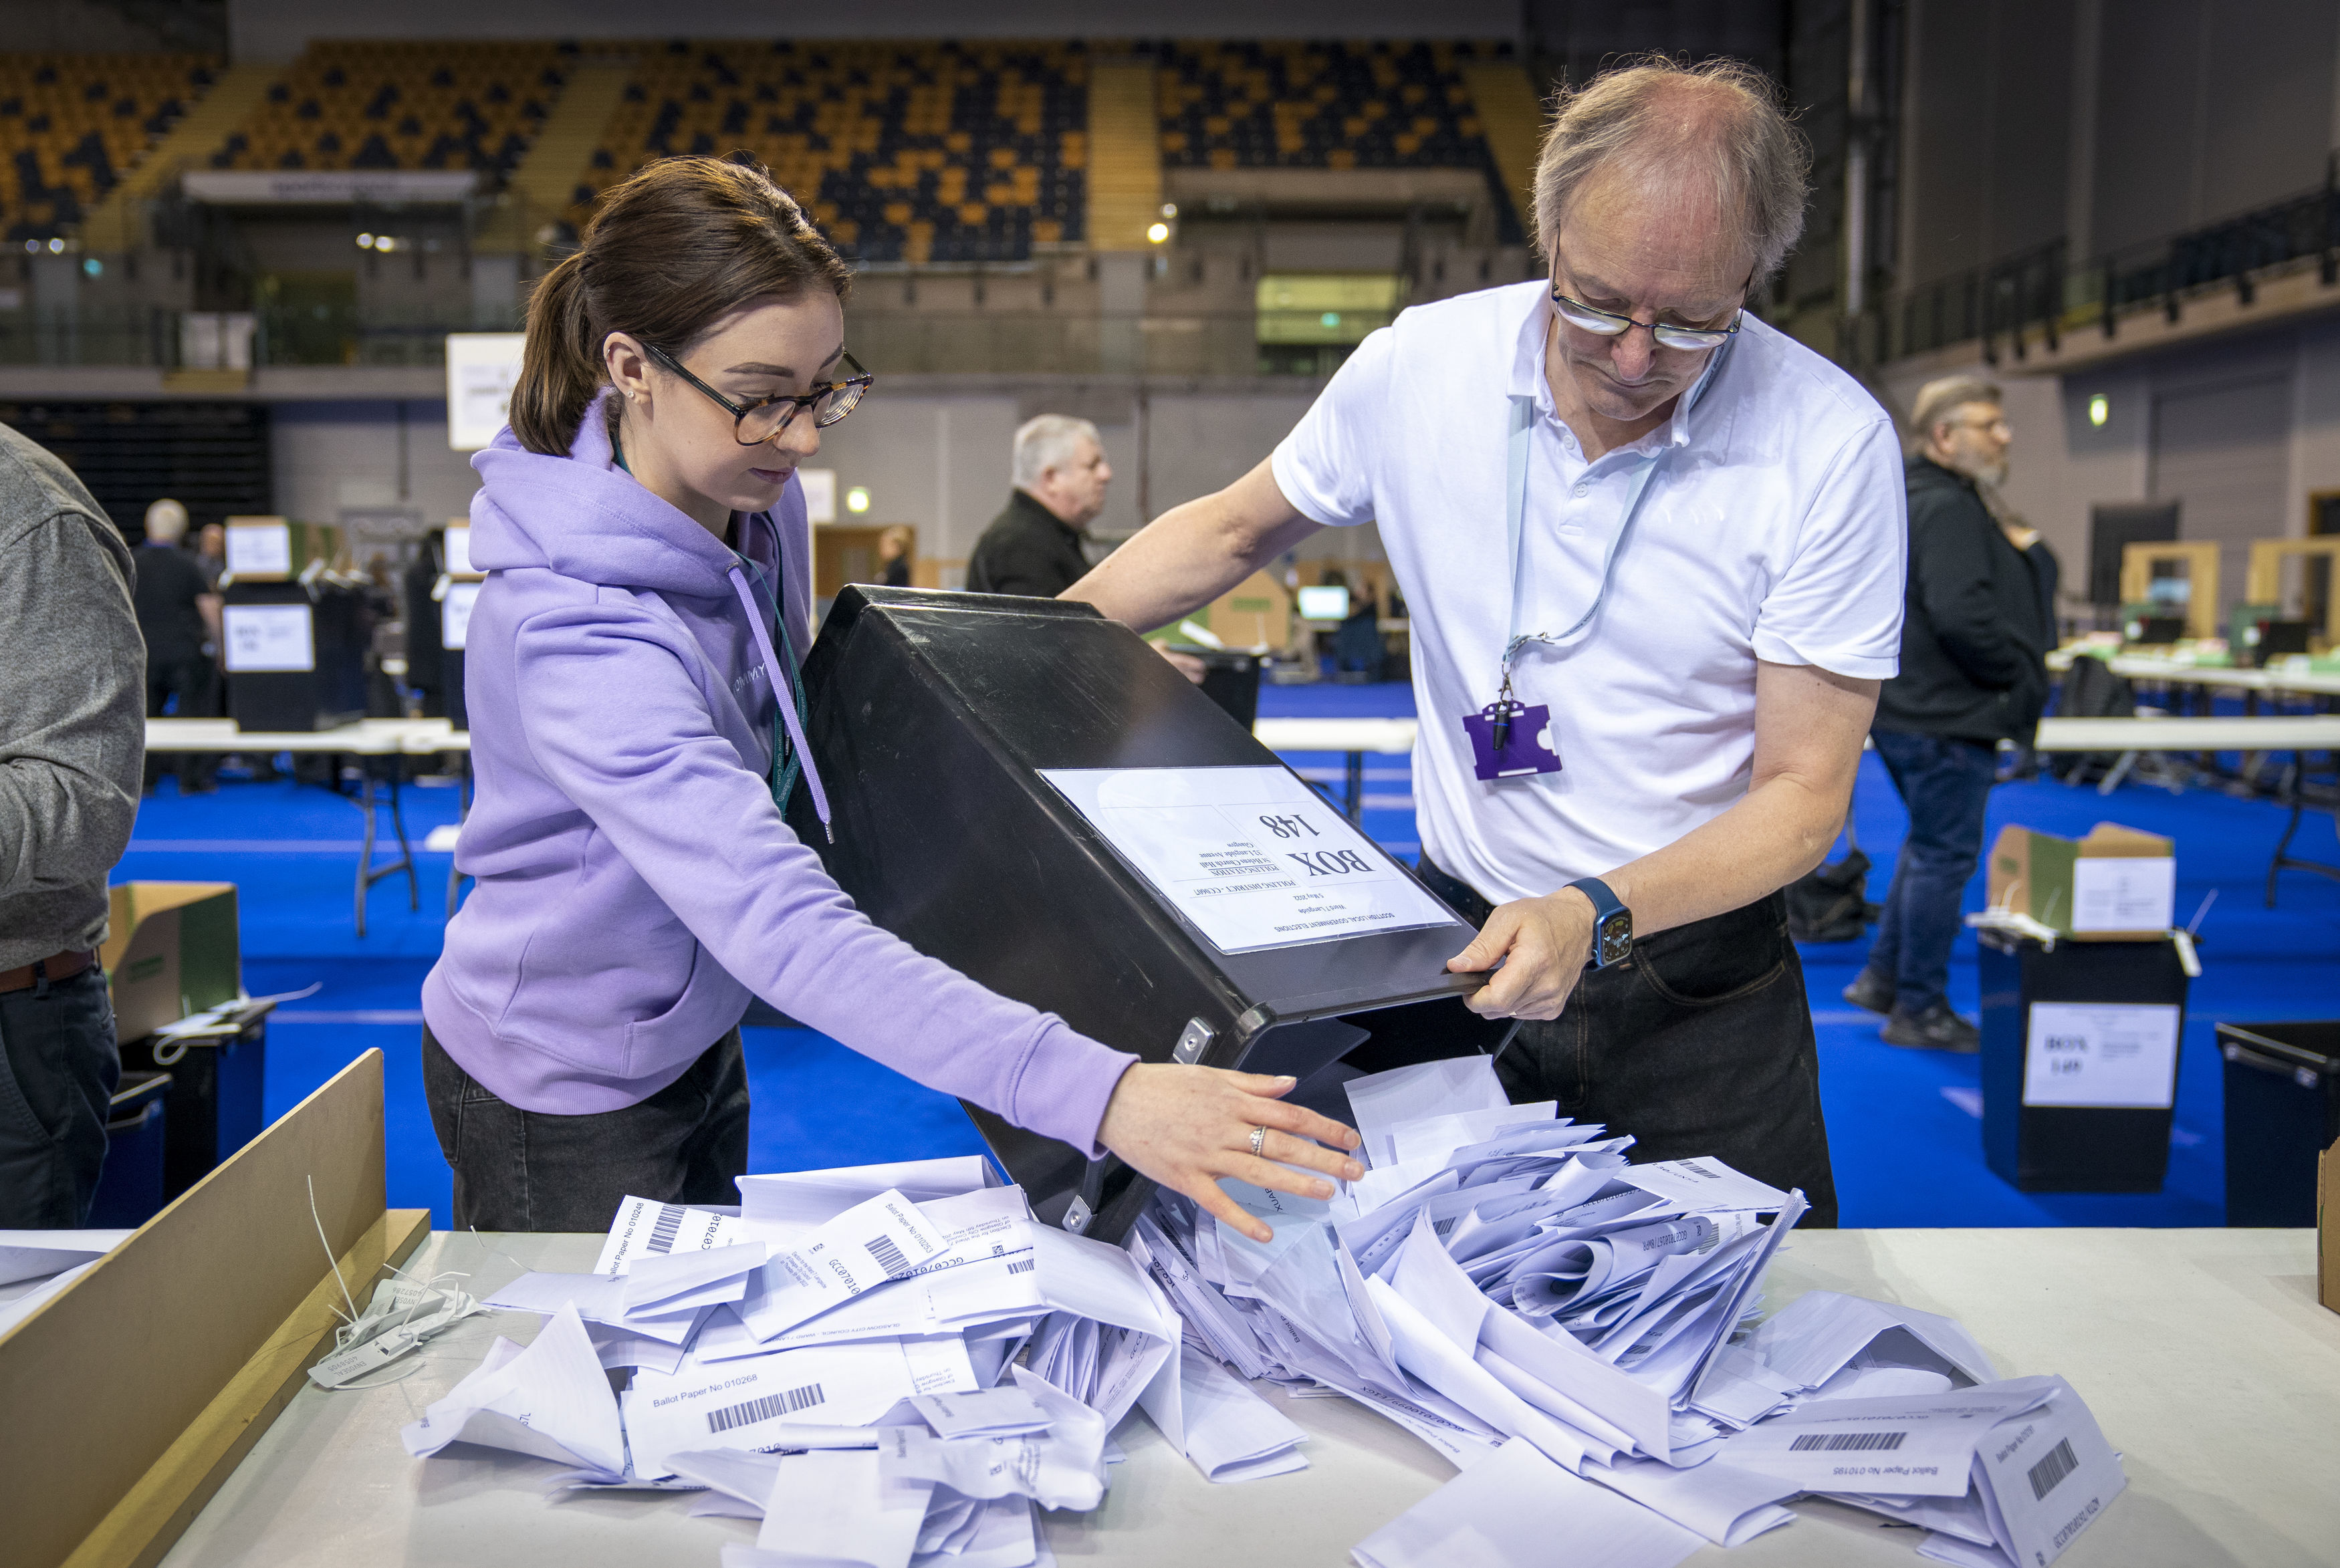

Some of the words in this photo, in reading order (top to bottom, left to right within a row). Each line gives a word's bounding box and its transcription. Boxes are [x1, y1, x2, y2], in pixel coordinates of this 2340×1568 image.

[1259, 814, 1320, 838] 148
[1225, 850, 1254, 858] Langside
[1217, 860, 1241, 868] Church
[1285, 850, 1376, 876] BOX
[1213, 868, 1246, 877] STATION
[1248, 864, 1280, 873] POLLING
[1225, 883, 1261, 893] DISTRICT
[1262, 880, 1296, 890] POLLING
[1193, 887, 1220, 896] CC0607
[1350, 915, 1367, 923] LOCAL
[1369, 912, 1395, 920] SCOTTISH
[1274, 922, 1309, 932] ELECTIONS
[1309, 918, 1349, 928] GOVERNMENT
[628, 1202, 645, 1227] 010248
[976, 1218, 1000, 1228] Thursday
[980, 1222, 1004, 1231] Glasgow
[624, 1228, 634, 1238] No
[885, 1203, 899, 1216] Ballot
[896, 1212, 911, 1228] Paper
[909, 1226, 916, 1235] No
[915, 1232, 933, 1254] 010253
[989, 1224, 1012, 1234] Election
[615, 1240, 628, 1260] Paper
[609, 1262, 620, 1276] allot
[392, 1287, 423, 1297] 4057286
[1286, 1322, 1300, 1343] Ballot
[328, 1356, 358, 1371] 4058905
[334, 1361, 367, 1377] ENVOSEAL
[653, 1394, 679, 1408] Ballot
[681, 1387, 707, 1402] Paper
[710, 1384, 723, 1394] No
[724, 1374, 758, 1390] 010268
[1833, 1467, 1865, 1475] 010195
[1867, 1467, 1880, 1475] No
[1882, 1466, 1909, 1476] Paper
[1912, 1466, 1938, 1476] Ballot
